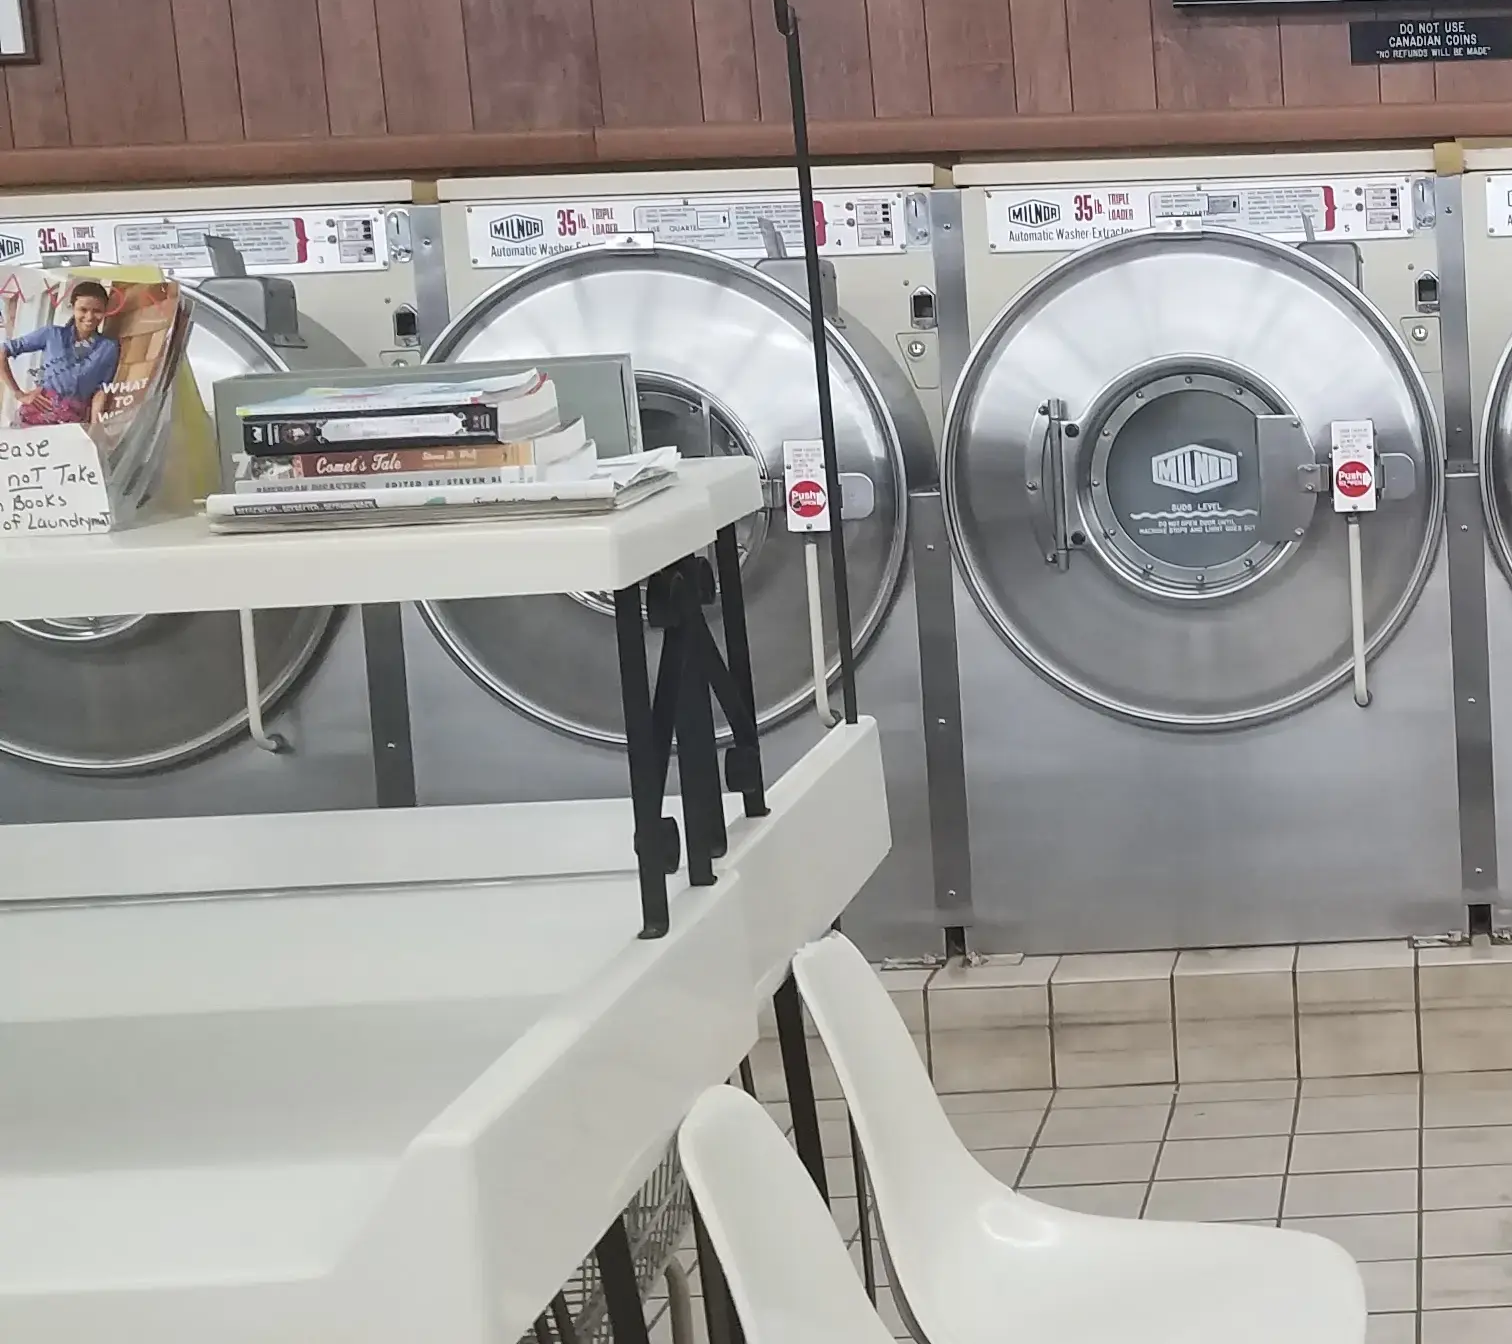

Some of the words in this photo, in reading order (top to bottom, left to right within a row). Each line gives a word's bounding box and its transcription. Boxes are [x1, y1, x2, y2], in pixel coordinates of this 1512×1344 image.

[1400, 24, 1413, 35] DO
[1419, 23, 1439, 33] NOT
[1445, 22, 1465, 32] USE
[1389, 36, 1441, 47] CANADIAN
[1446, 34, 1477, 45] COINS
[1393, 50, 1427, 58] REFUNDS
[1432, 49, 1449, 57] WILL
[1108, 193, 1129, 205] TRIPLE
[591, 208, 613, 220] TRIPLE
[1012, 204, 1057, 224] MILNOR
[1074, 195, 1093, 221] 35
[1095, 199, 1105, 214] lb.
[1108, 209, 1133, 220] LOADER
[557, 210, 577, 237] 35
[578, 213, 589, 229] lb.
[73, 226, 95, 238] TRIPLE
[493, 219, 540, 242] MILNOR
[1009, 229, 1054, 241] Automatic
[0, 237, 20, 255] NOR
[38, 227, 57, 252] 35
[59, 232, 69, 247] lb.
[491, 245, 537, 257] Automatic
[103, 378, 148, 393] WHAT
[114, 395, 133, 408] TO
[0, 440, 49, 459] ease
[316, 456, 367, 475] Comet's
[372, 453, 401, 471] Tale
[1339, 471, 1362, 480] Push
[792, 490, 817, 500] Push
[3, 513, 20, 530] of
